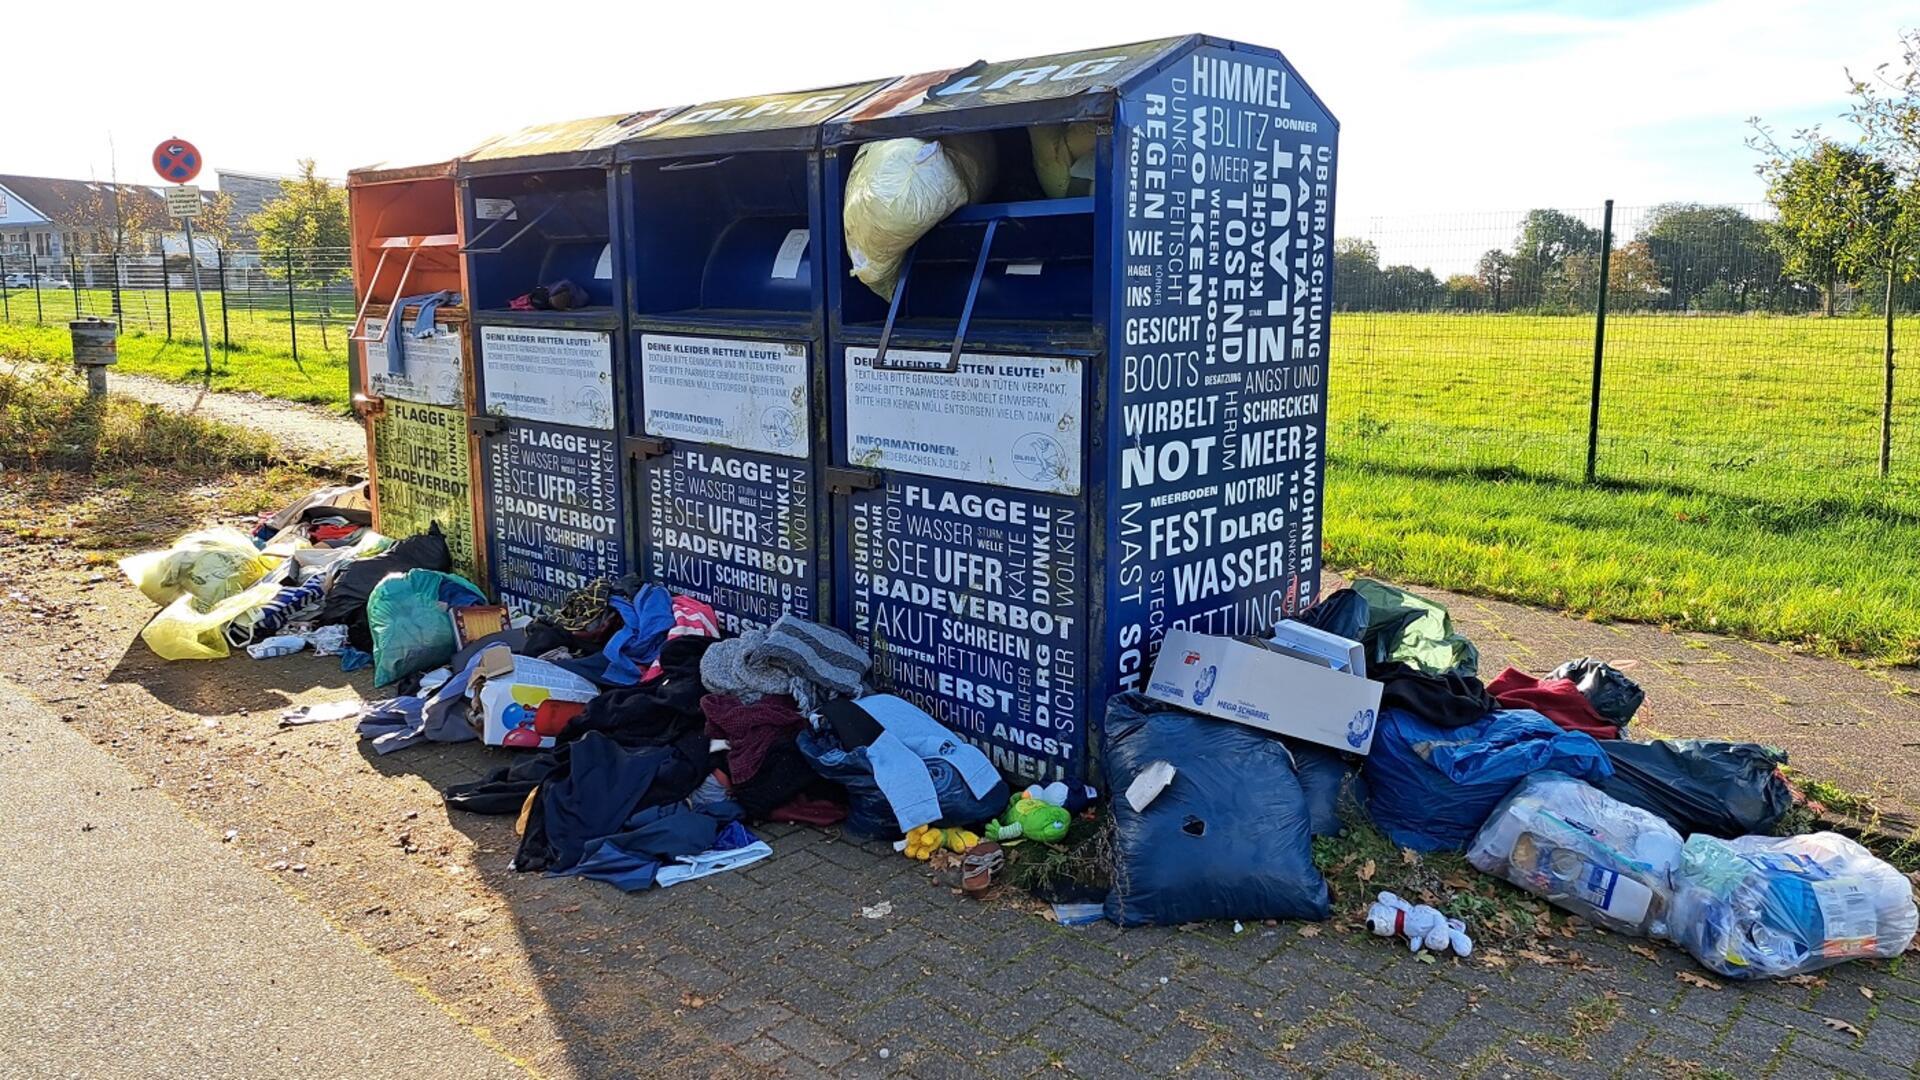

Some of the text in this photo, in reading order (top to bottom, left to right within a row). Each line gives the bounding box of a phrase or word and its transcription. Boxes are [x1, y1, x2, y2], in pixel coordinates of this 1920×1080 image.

[936, 56, 1127, 96] LRG
[1193, 55, 1291, 110] HIMMEL
[1211, 106, 1269, 151] BLITZ
[1274, 117, 1317, 133] DONNER
[1129, 125, 1142, 218] TROPFEN
[1144, 93, 1166, 219] REGEN
[1210, 155, 1248, 183] MEER
[1168, 78, 1186, 305] DUNKEL PEITSCHT
[1188, 106, 1207, 305] WOLKEN
[1128, 230, 1163, 256] WIE
[1250, 160, 1268, 297] KRACHEN
[1267, 139, 1293, 316] LAUT
[1127, 265, 1152, 277] HAGEL
[1292, 143, 1312, 359] KAPITÄNE
[1308, 146, 1332, 358] ÜBERRASCHUNG
[1127, 287, 1152, 307] INS
[1206, 189, 1220, 365] WELLEN HOCH
[1222, 192, 1247, 363] TOSEND
[648, 343, 671, 351] DEINE
[674, 344, 710, 354] KLEIDER
[712, 348, 746, 357] RETTEN
[1126, 315, 1201, 346] GESICHT
[1247, 326, 1285, 364] IN
[854, 357, 887, 366] DEIE
[947, 363, 994, 375] ETTEN
[999, 366, 1044, 378] LEUTE!
[855, 369, 888, 380] TEXTILIEN
[891, 372, 910, 383] BITTE
[912, 375, 960, 387] GEWASCHEN
[993, 378, 1018, 391] TÜTEN
[1124, 351, 1199, 393] BOOTS
[1204, 372, 1241, 386] BESATZUNG
[1245, 364, 1320, 395] ANGST UND
[855, 395, 874, 406] BITTE
[884, 385, 903, 395] BITTE
[906, 387, 948, 400] PAARWEISE
[1243, 394, 1319, 424] SCHRECKEN
[395, 406, 446, 427] FLAGGE
[1123, 395, 1219, 437] WIRBELT
[1222, 390, 1238, 471] HERUM
[410, 445, 439, 472] UFER
[448, 413, 458, 476] DUNKLE
[520, 428, 587, 454] FLAGGE
[521, 450, 560, 471] WASSER
[856, 435, 959, 457] INFORMATIONEN:
[1121, 436, 1216, 489] NOT
[1240, 425, 1301, 469] MEER
[385, 465, 468, 498] BADEVERBOT
[512, 468, 577, 506] SEE UFER
[590, 439, 603, 511] DUNKLE
[602, 440, 616, 512] WOLKEN
[673, 450, 685, 493] ROTE
[686, 452, 773, 484] FLAGGE
[687, 475, 735, 502] WASSER
[1224, 473, 1284, 506] NOTRUF
[504, 496, 616, 535] BADEVERBOT
[776, 466, 790, 550] DUNKLE
[793, 469, 807, 551] WOLKEN
[887, 482, 901, 534] ROTE
[905, 485, 1027, 525] FLAGGE
[1150, 485, 1218, 508] MEERBODEN
[1301, 424, 1318, 571] ANWOHNER
[507, 517, 594, 551] AKUT SCHREIEN
[650, 467, 664, 578] TOURISTEN
[674, 497, 758, 543] SEE UFER
[759, 490, 774, 547] KÄLTE
[873, 505, 882, 569] GEFAHR
[906, 514, 973, 547] WASSER
[1150, 507, 1217, 560] FEST
[1220, 507, 1284, 544] DLRG
[543, 544, 586, 570] RETTUNG
[665, 528, 808, 579] BADEVERBOT
[854, 502, 870, 632] TOURISTEN
[887, 537, 1003, 595] SEE UFER
[977, 539, 1004, 553] WELLE
[1005, 531, 1026, 600] KÄLTE
[1033, 505, 1050, 605] DUNKLE
[1056, 508, 1075, 607] WOLKEN
[1120, 502, 1143, 606] MAST
[545, 566, 587, 589] ERST
[667, 552, 778, 597] AKUT SCHREIEN
[1173, 541, 1284, 606] WASSER
[713, 585, 767, 617] RETTUNG
[873, 574, 1075, 639] BADEVERBOT
[875, 602, 938, 648] AKUT
[942, 618, 1031, 661] SCHREIEN
[938, 643, 1013, 685] RETTUNG
[938, 673, 1014, 714] ERST
[1017, 666, 1031, 724] HELFER
[1036, 644, 1050, 728] DLRG
[1054, 649, 1075, 733] SICHER
[992, 722, 1073, 759] ANGST
